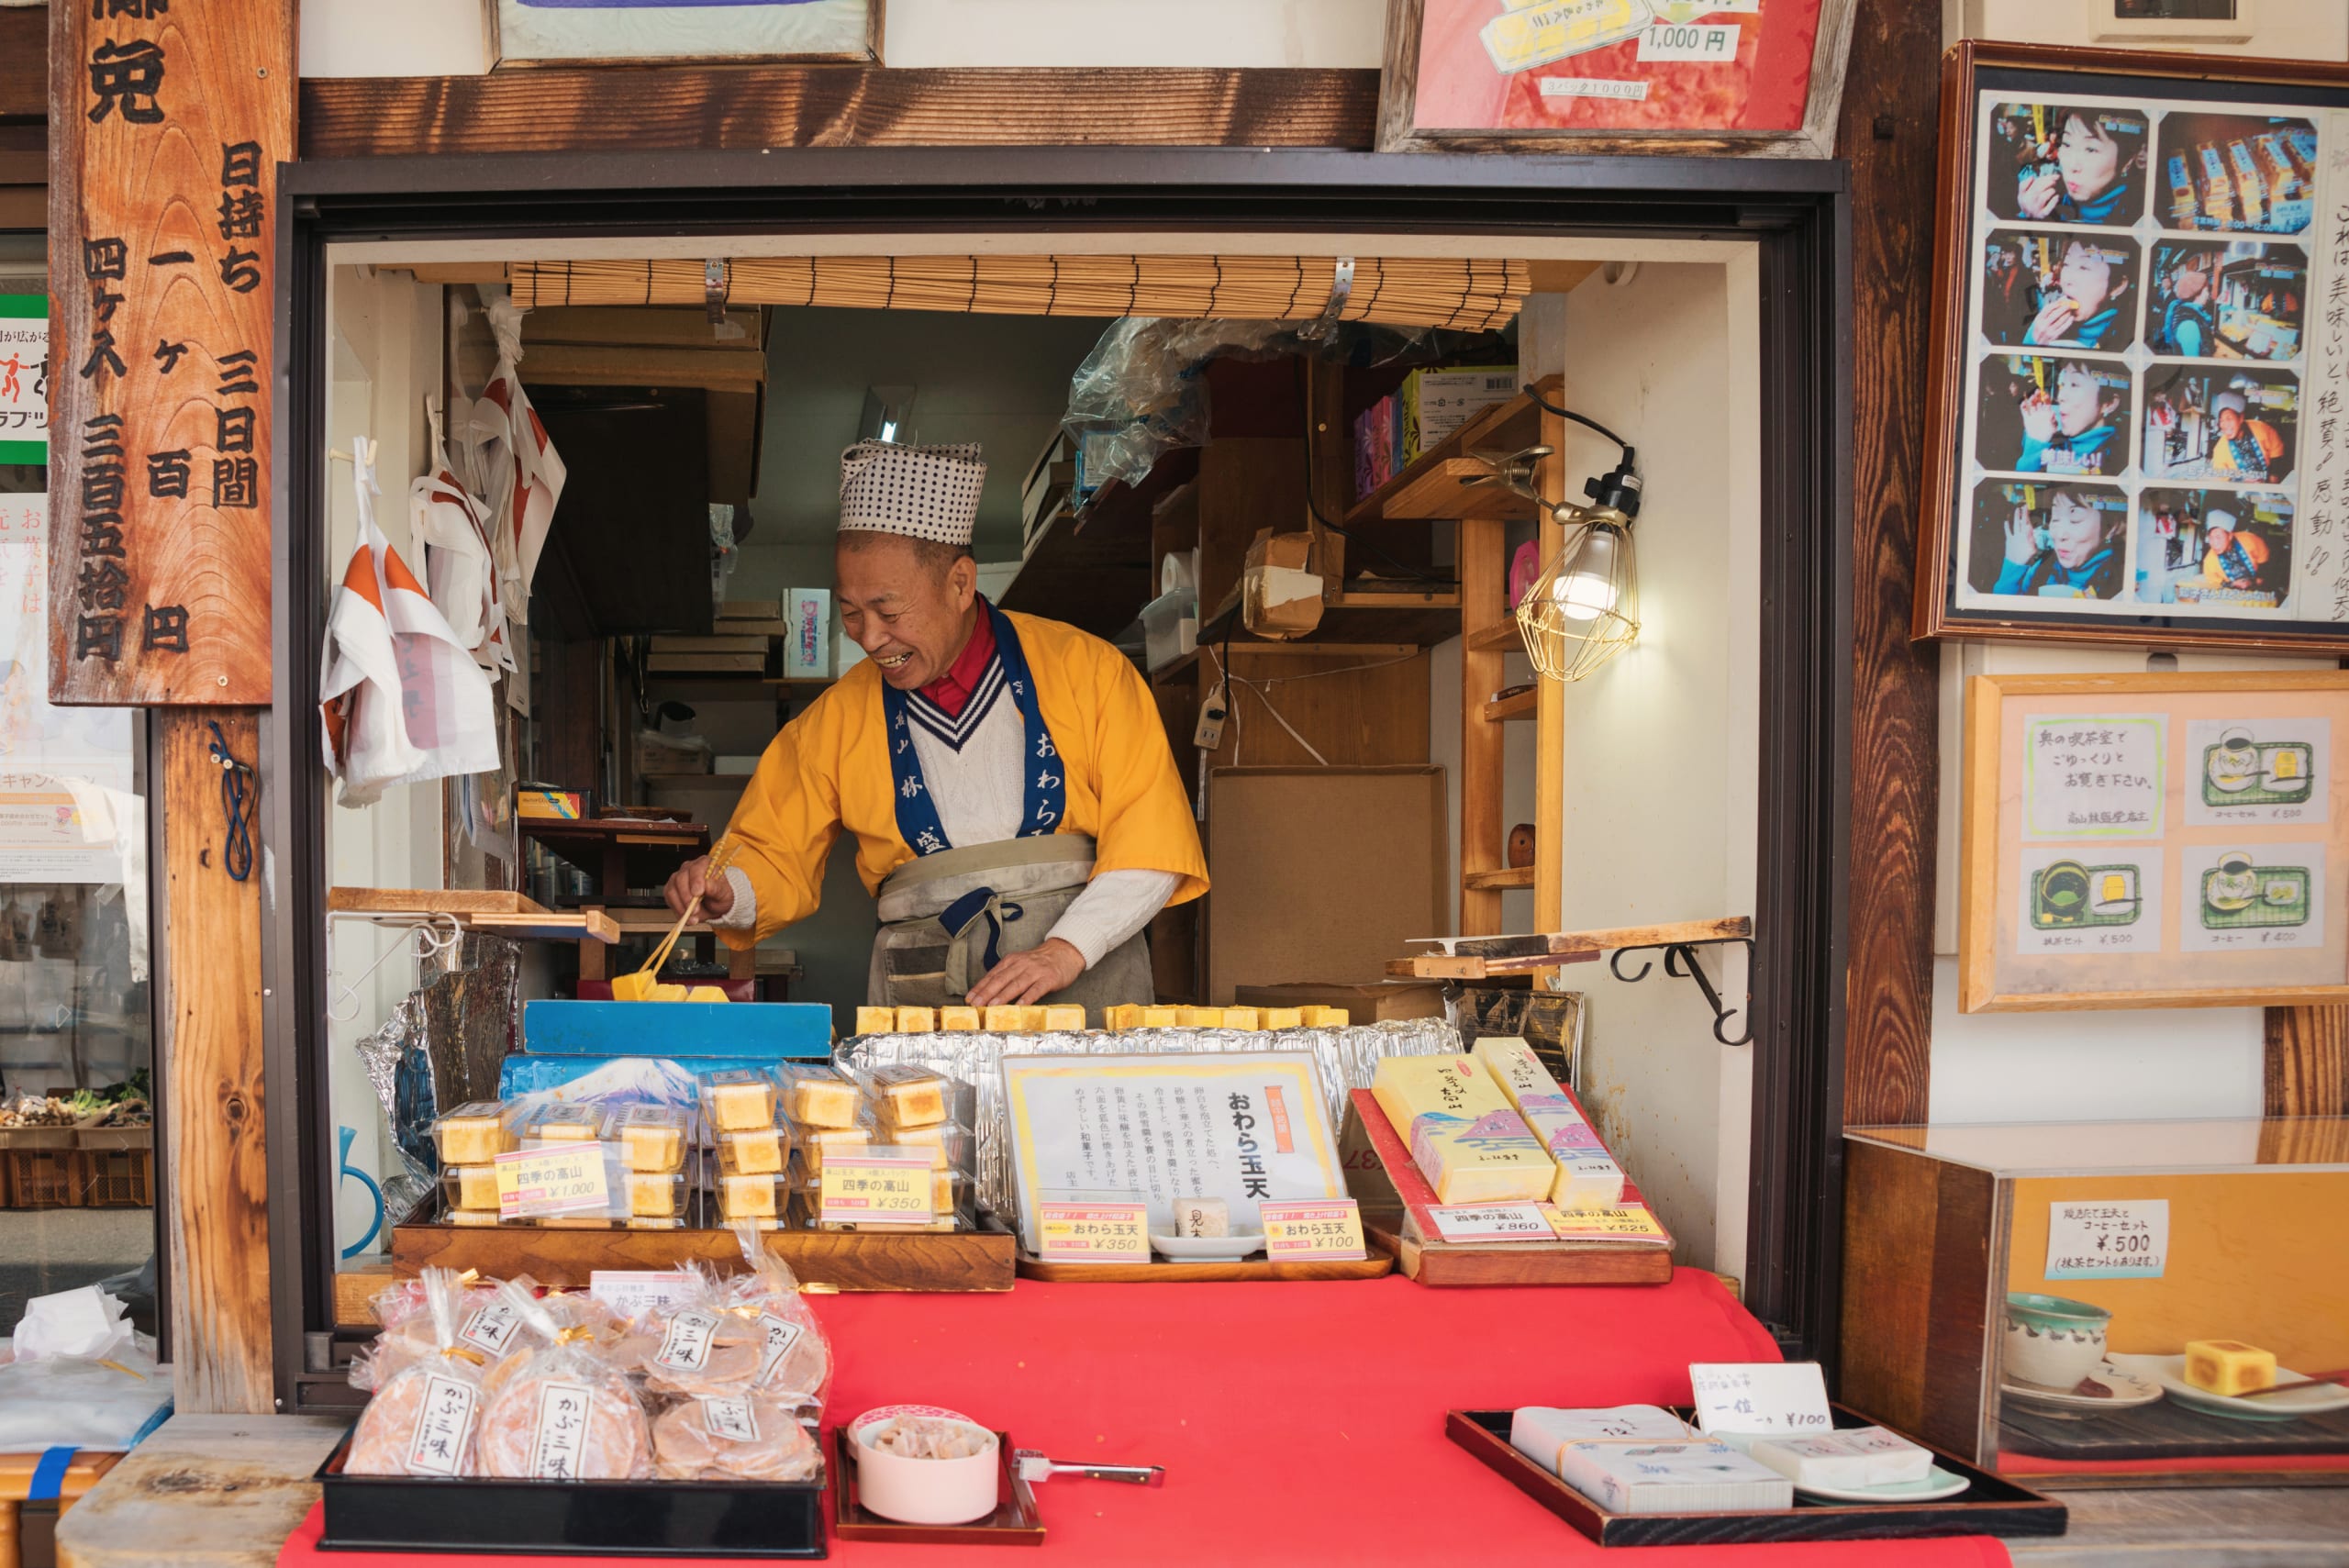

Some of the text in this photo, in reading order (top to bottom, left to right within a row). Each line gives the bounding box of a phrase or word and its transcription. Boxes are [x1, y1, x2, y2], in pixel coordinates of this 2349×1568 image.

[212, 139, 264, 509] 日持ち 三日間
[1228, 1092, 1271, 1198] おわら玉天
[517, 1165, 583, 1184] 四季の高山
[842, 1179, 910, 1192] 四季の高山
[876, 1196, 921, 1209] ¥350
[1454, 1213, 1523, 1222] 四季の高山
[1074, 1223, 1139, 1236] おわら玉天
[1286, 1222, 1346, 1236] おわら玉天
[1495, 1221, 1540, 1231] ¥860
[1606, 1224, 1650, 1232] ¥525
[2084, 1220, 2149, 1231] コーヒーセット
[1094, 1239, 1138, 1251] ¥350
[1315, 1236, 1353, 1248] ¥100
[429, 1387, 466, 1460] かぶ三味
[1786, 1412, 1827, 1428] ¥100
[548, 1397, 583, 1478] かぶ三味
